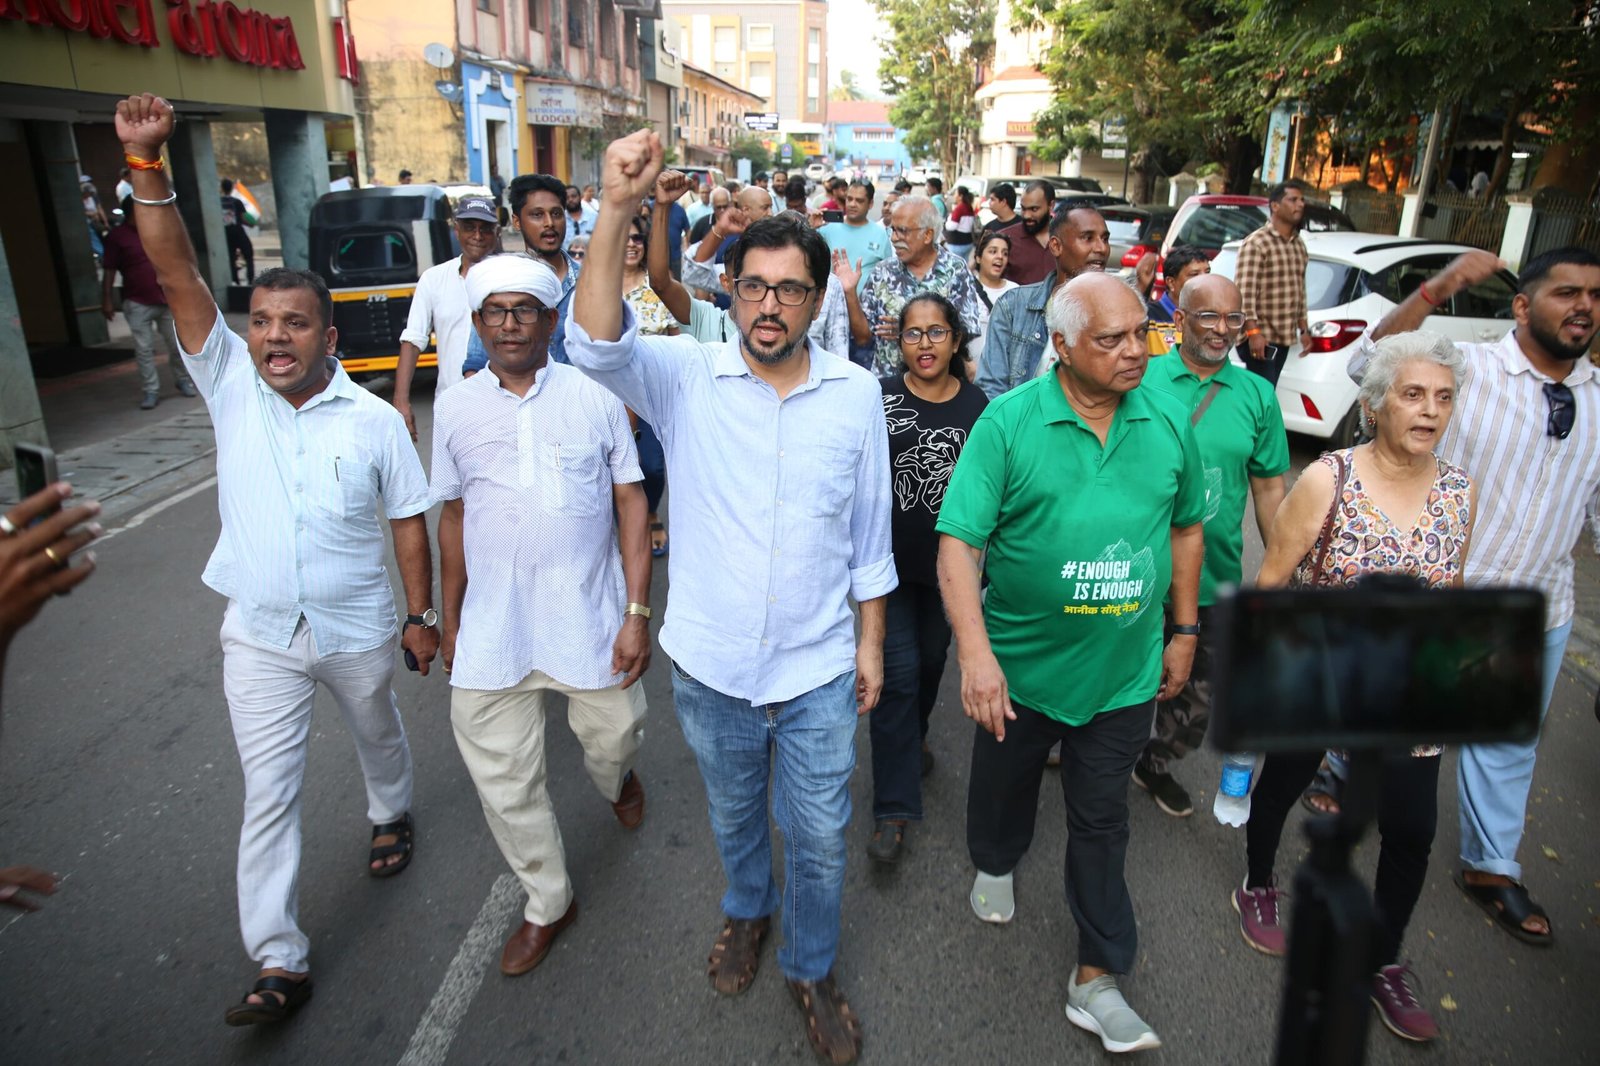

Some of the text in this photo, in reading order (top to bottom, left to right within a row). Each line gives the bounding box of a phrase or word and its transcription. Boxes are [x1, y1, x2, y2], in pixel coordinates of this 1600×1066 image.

[535, 115, 571, 123] LODGE
[368, 294, 388, 302] TVS
[1061, 561, 1130, 579] #ENOUGH
[1073, 580, 1143, 600] IS ENOUGH
